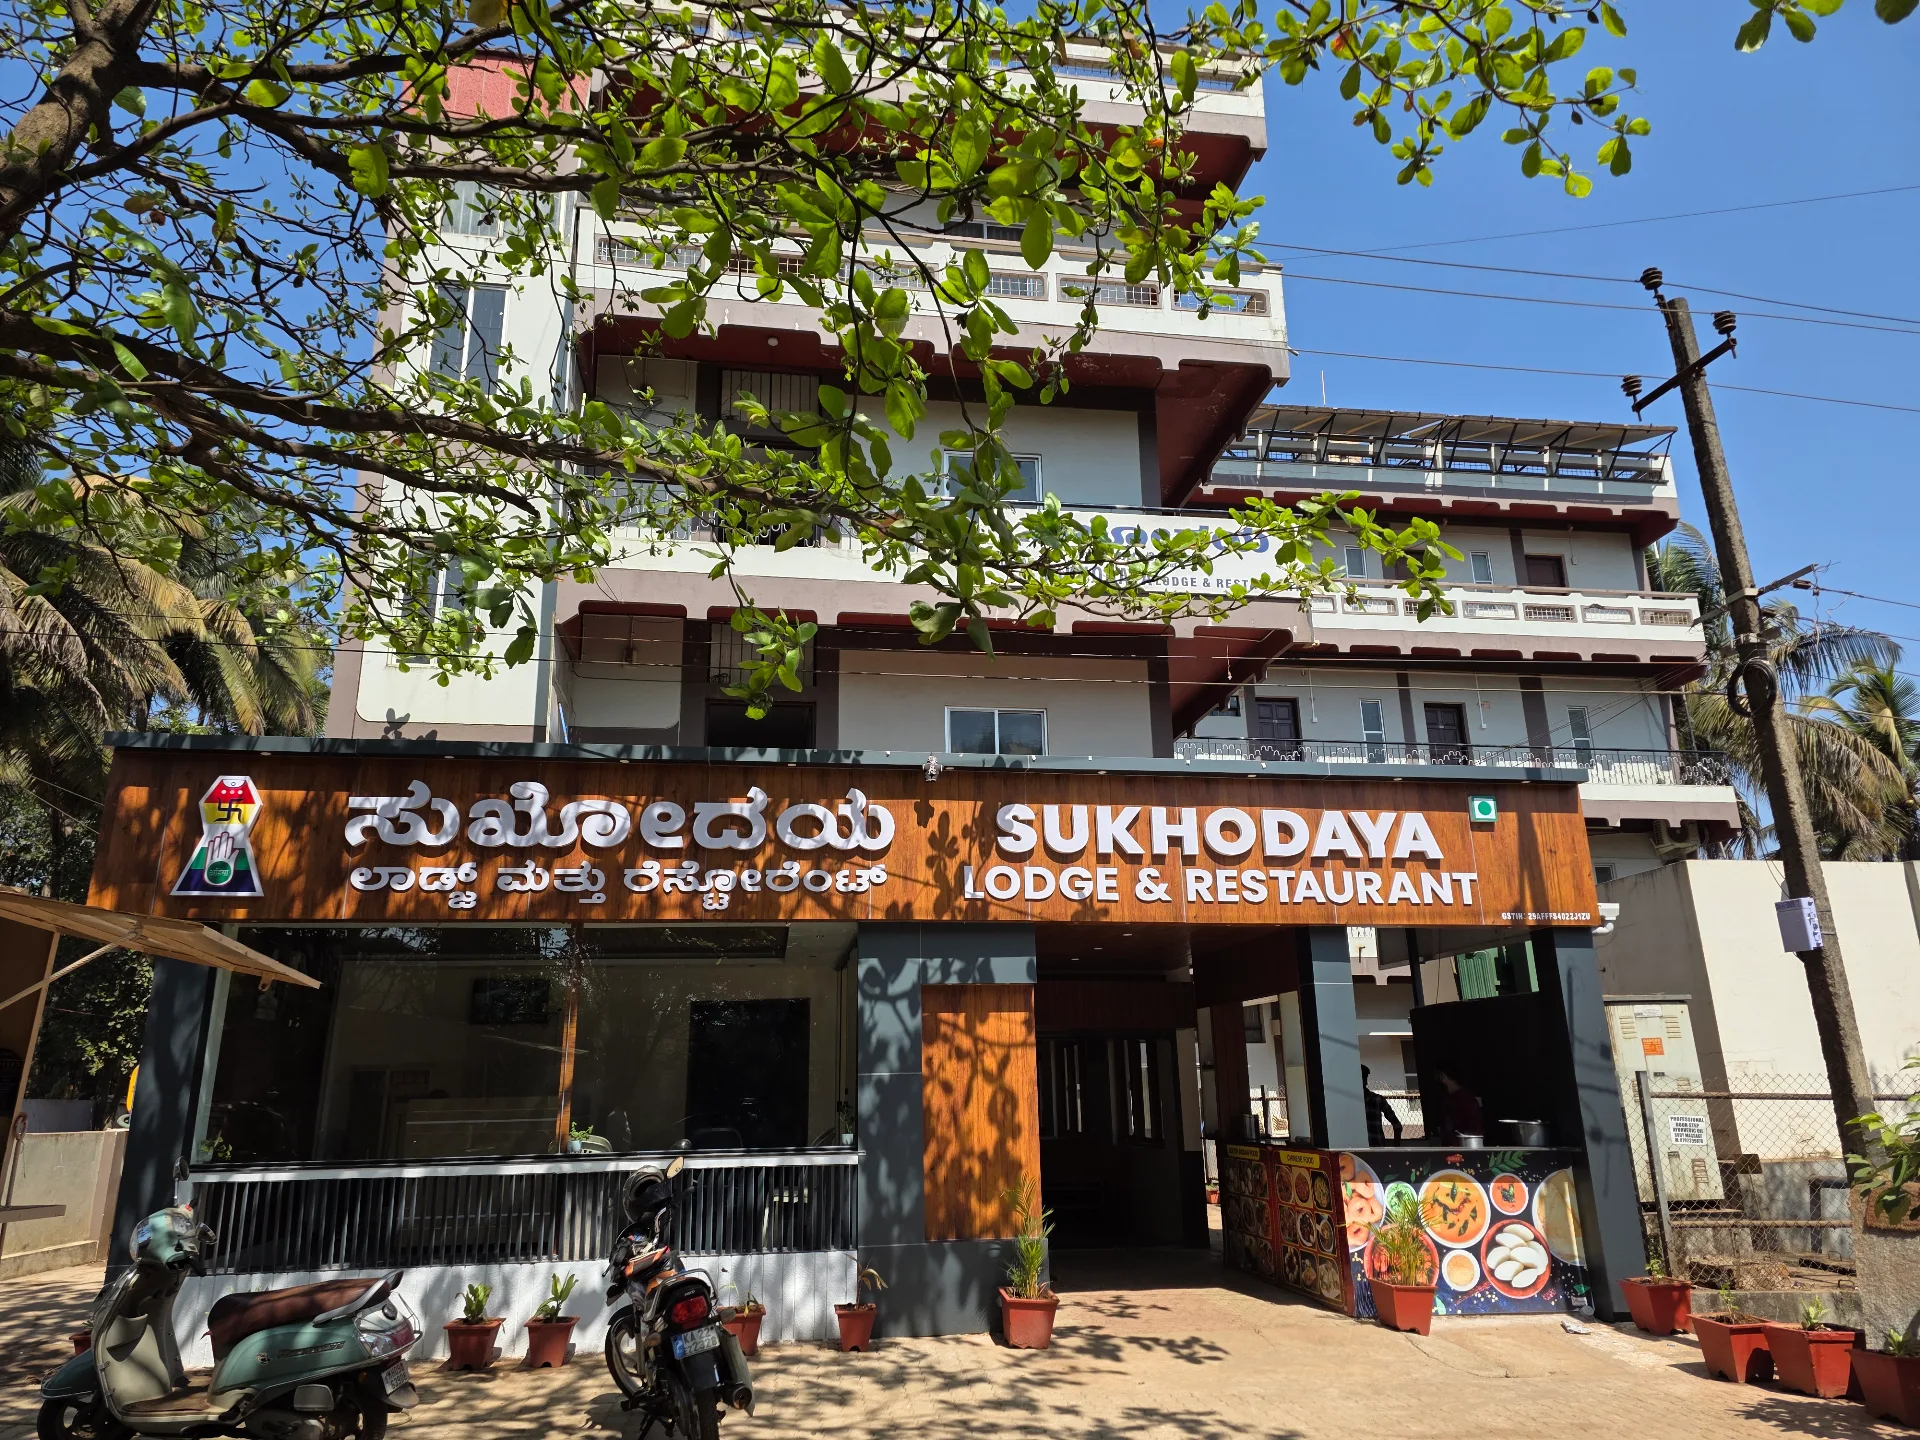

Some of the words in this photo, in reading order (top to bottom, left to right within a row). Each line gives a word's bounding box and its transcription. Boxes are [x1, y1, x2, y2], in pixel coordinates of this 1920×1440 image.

[1203, 577, 1211, 587] &
[345, 779, 896, 852] ಸುಖೋದಯ
[995, 803, 1445, 861] SUKHODAYA
[496, 860, 607, 904] ಮತ್ತು
[963, 865, 1119, 902] LODGE
[1136, 869, 1171, 902] &
[1187, 869, 1479, 905] RESTAURANT
